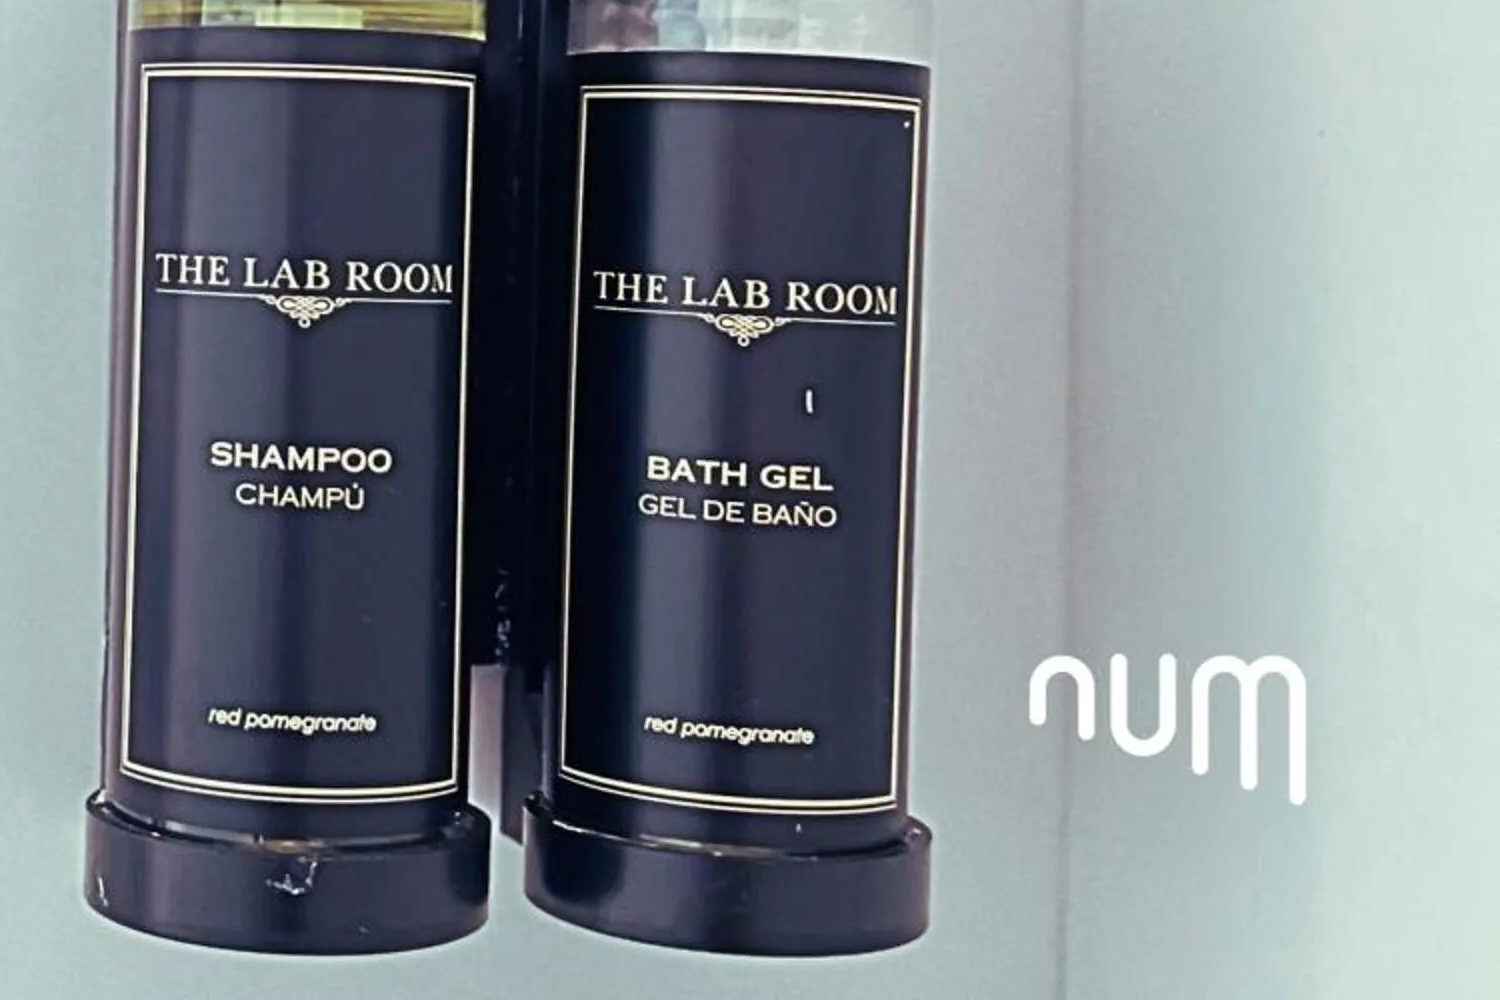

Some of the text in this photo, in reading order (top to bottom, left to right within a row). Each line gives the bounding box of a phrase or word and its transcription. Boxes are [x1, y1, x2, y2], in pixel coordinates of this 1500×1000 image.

[155, 252, 453, 293] THE LAB ROOM
[593, 271, 897, 316] THE LAB ROOM
[210, 441, 393, 474] SHAMPOO
[647, 455, 834, 492] BATH GEL
[235, 482, 365, 510] CHAMPÚ
[638, 493, 837, 528] GEL DE BAÑO
[208, 708, 377, 735] red pomegranate
[644, 717, 815, 745] red pomegranate
